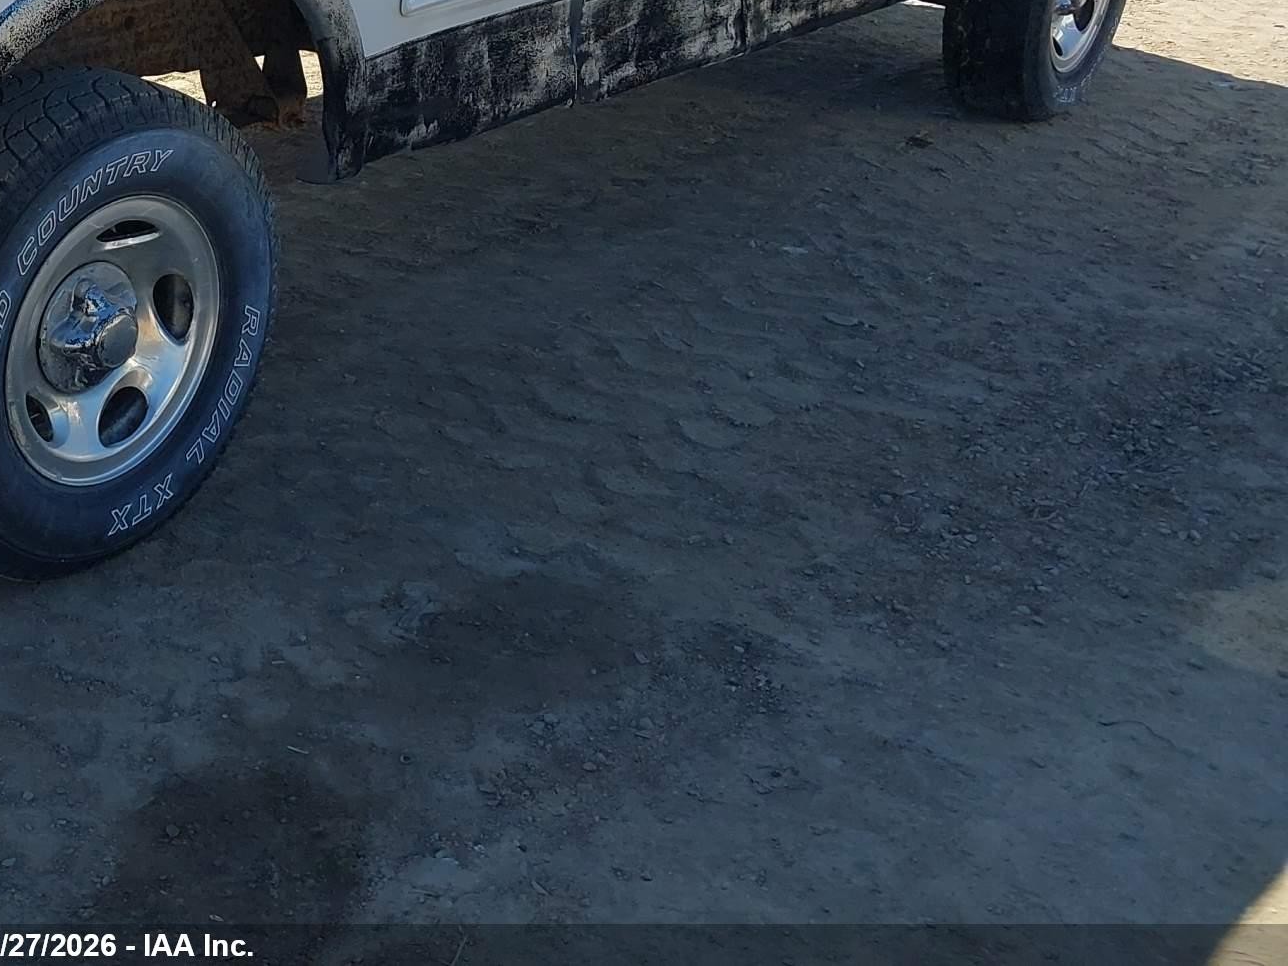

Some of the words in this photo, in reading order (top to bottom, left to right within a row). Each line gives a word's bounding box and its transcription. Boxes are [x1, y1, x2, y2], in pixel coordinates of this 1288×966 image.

[17, 149, 174, 276] COUNTRY
[185, 305, 261, 465] RADIAL
[107, 472, 174, 537] XTX
